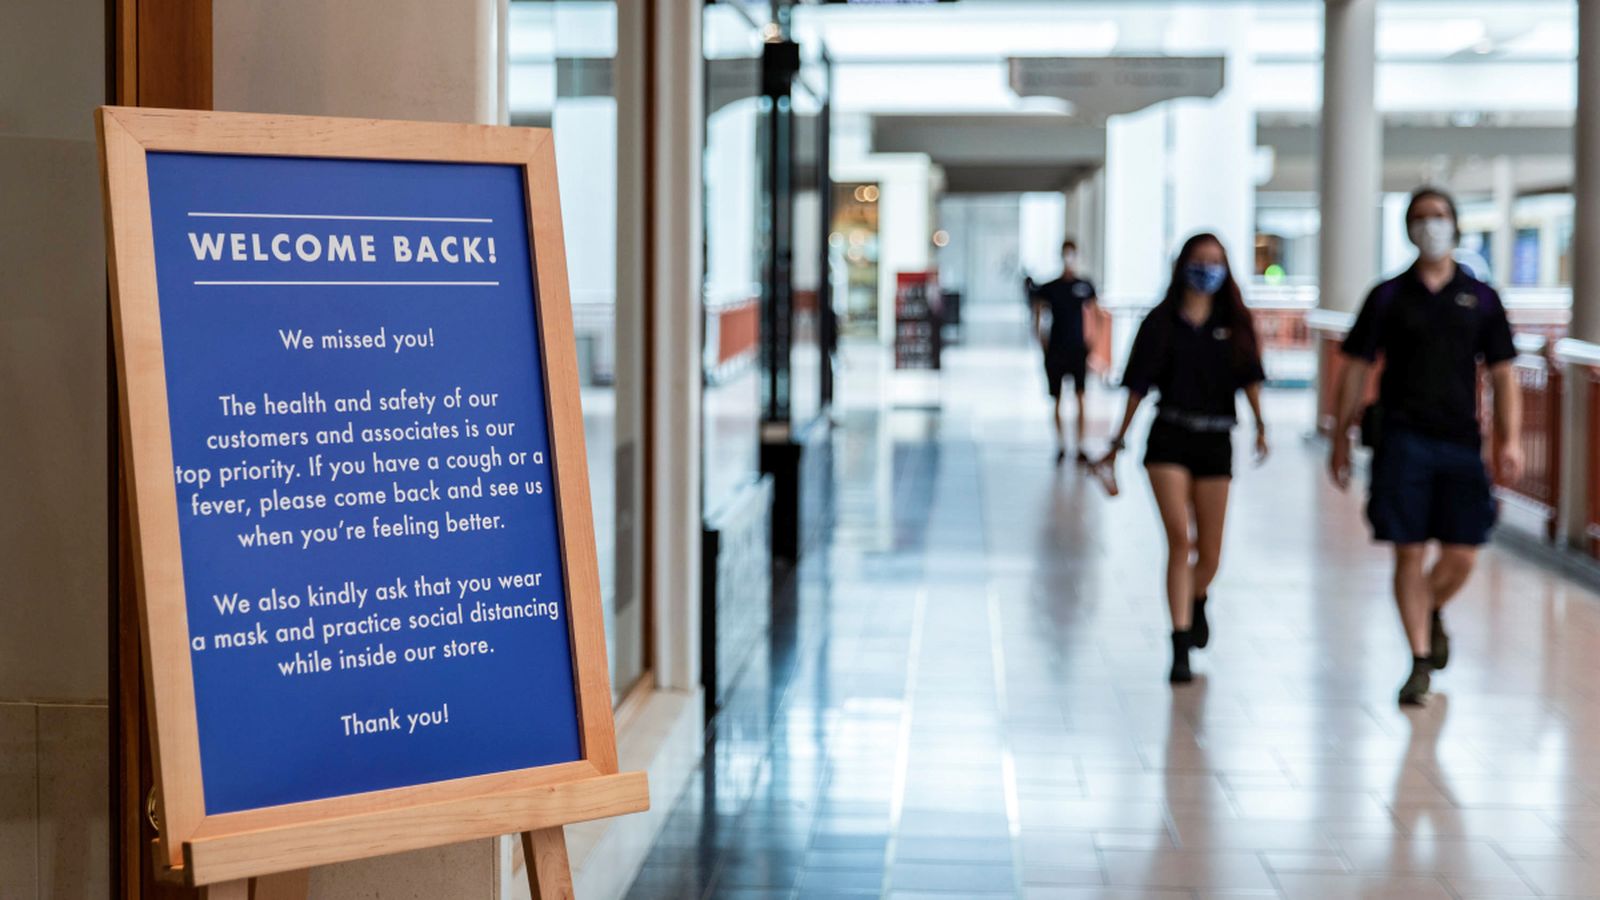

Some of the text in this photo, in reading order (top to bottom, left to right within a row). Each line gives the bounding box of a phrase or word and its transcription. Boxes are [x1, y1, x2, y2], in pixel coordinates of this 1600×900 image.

[188, 233, 496, 263] WELCOME BACK!
[279, 327, 434, 353] We missed you!
[219, 387, 498, 416] The health and safety of our
[207, 419, 515, 449] customers and associates is our
[175, 446, 544, 489] top priority. If you have a cough or a
[192, 477, 542, 517] fever, please come back and see us
[238, 525, 293, 547] when
[373, 515, 439, 539] feeling
[446, 512, 504, 532] better.
[213, 573, 541, 615] We also kindly ask that you wear
[192, 598, 558, 651] a mask and practice social distancing
[278, 640, 494, 675] while inside our store.
[341, 704, 448, 735] Thank you!
